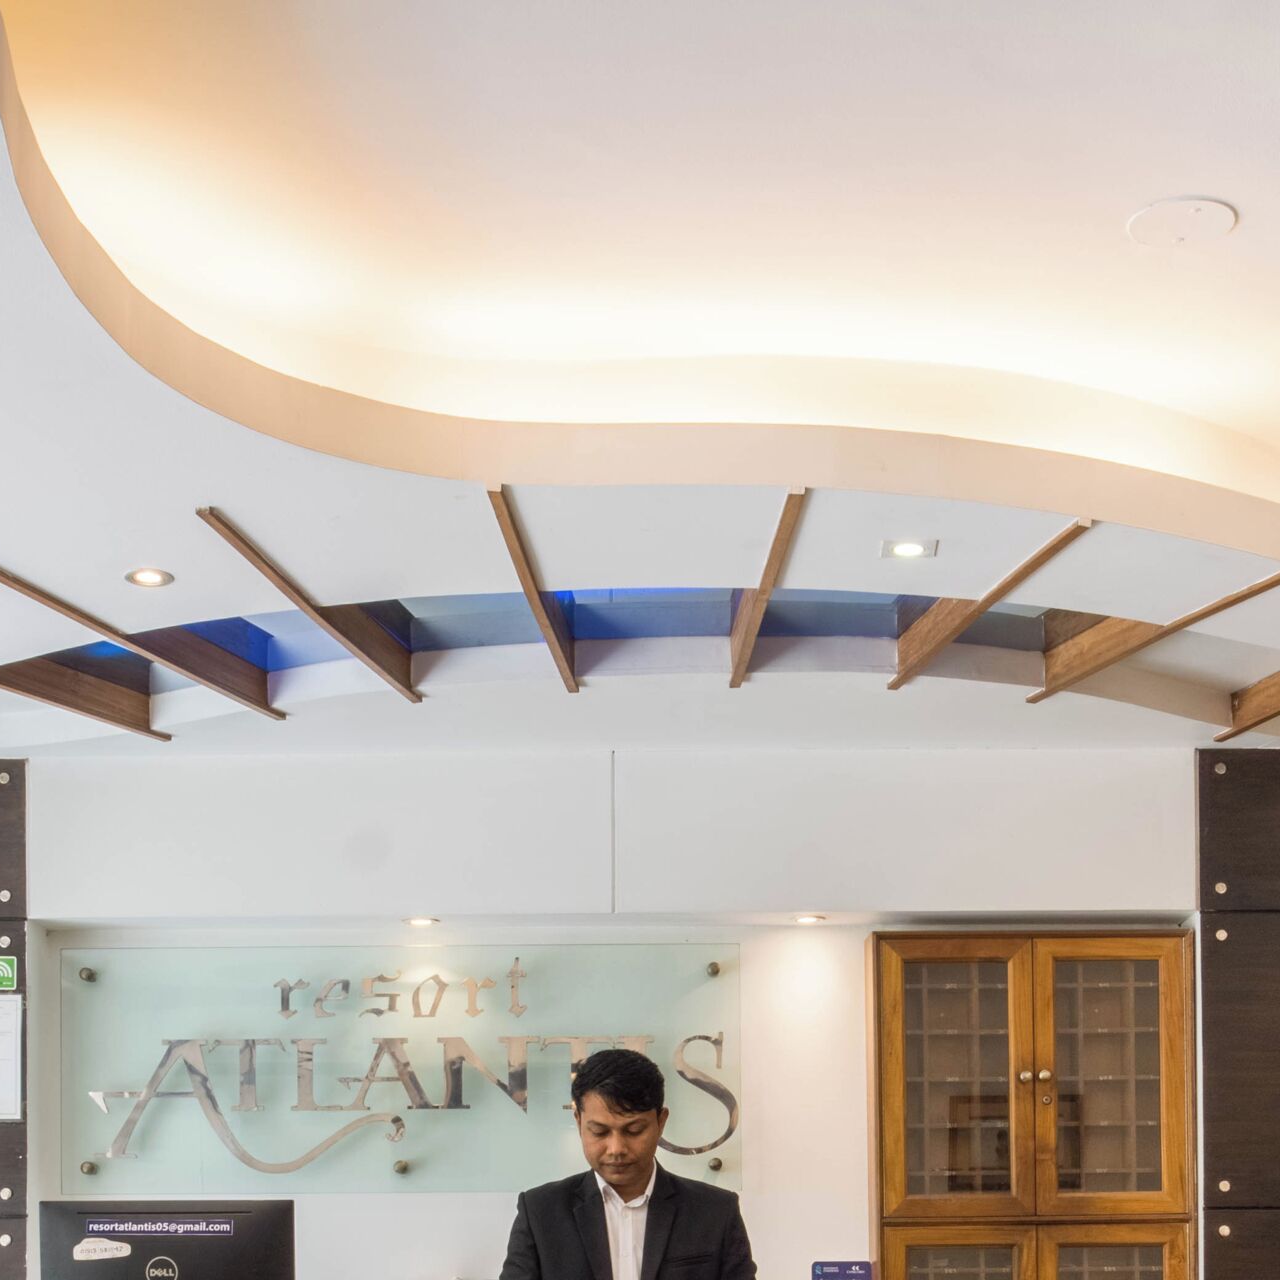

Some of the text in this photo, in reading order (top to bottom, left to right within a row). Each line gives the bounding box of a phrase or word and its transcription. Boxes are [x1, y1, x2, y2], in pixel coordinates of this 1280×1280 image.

[273, 956, 529, 1019] resort
[88, 1221, 231, 1234] resortatlantis05@gmail.com
[149, 1268, 175, 1277] DELL
